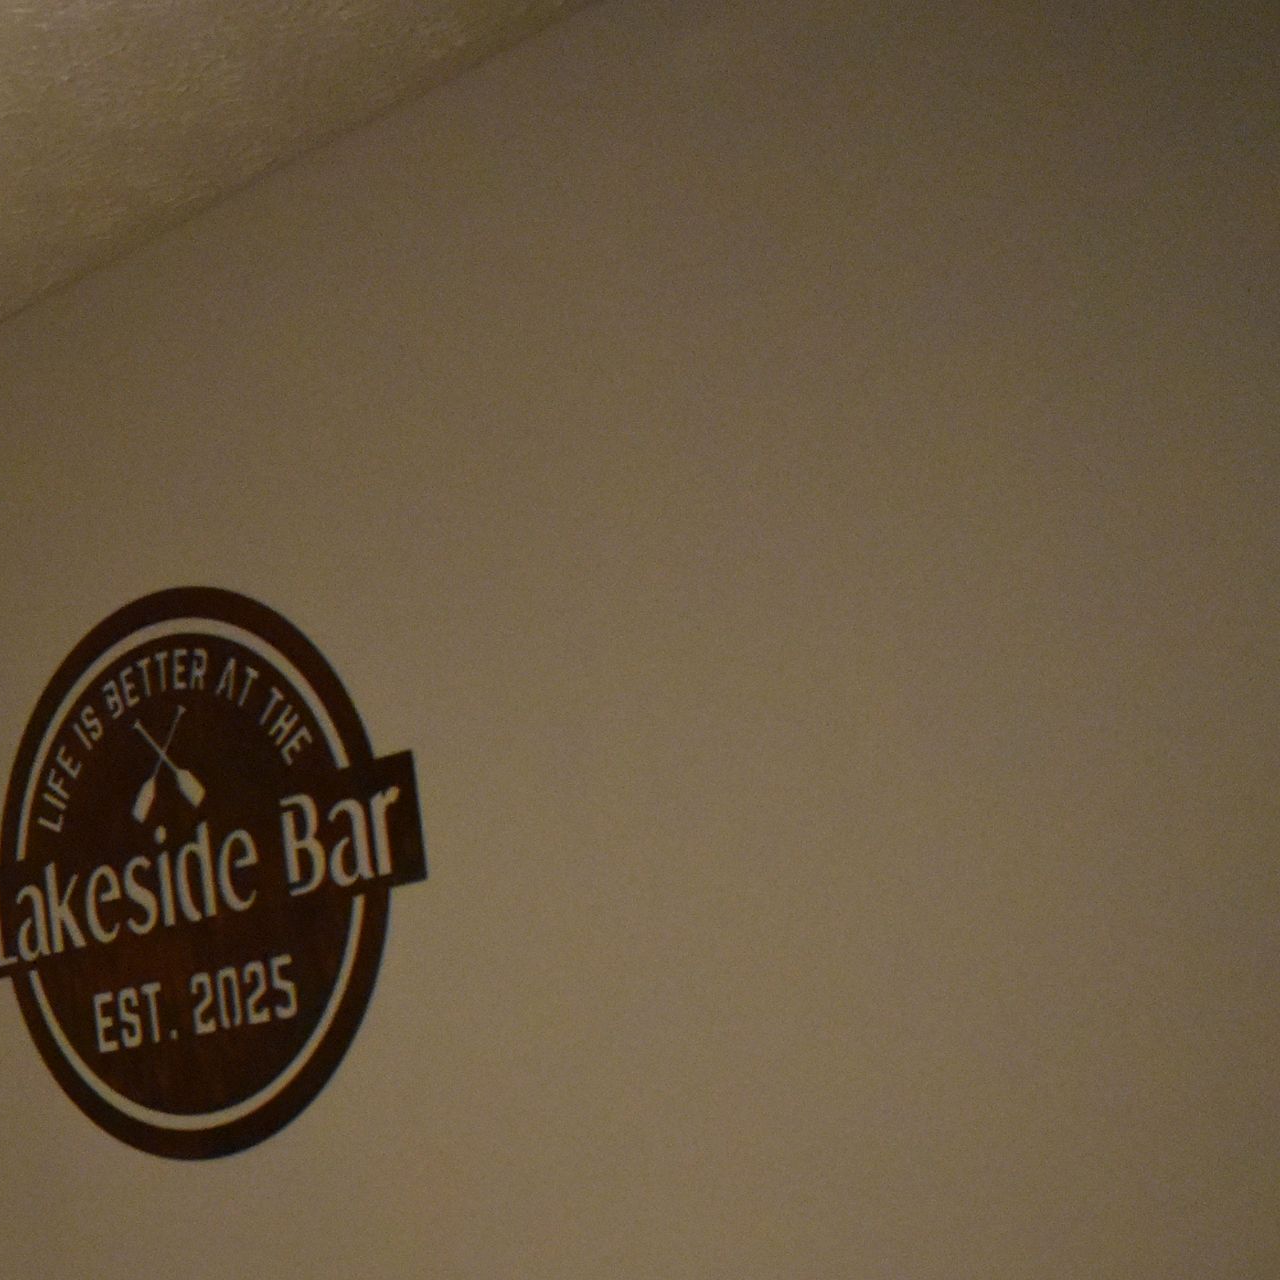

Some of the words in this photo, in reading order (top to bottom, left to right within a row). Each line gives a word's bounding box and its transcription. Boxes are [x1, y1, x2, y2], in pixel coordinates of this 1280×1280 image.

[38, 745, 83, 833] LIFE
[74, 701, 104, 750] IS
[102, 648, 208, 719] BETTER
[215, 657, 260, 708] AT
[257, 687, 313, 766] THE
[280, 786, 400, 896] Bar
[94, 981, 179, 1053] EST.
[190, 953, 298, 1036] 2025
